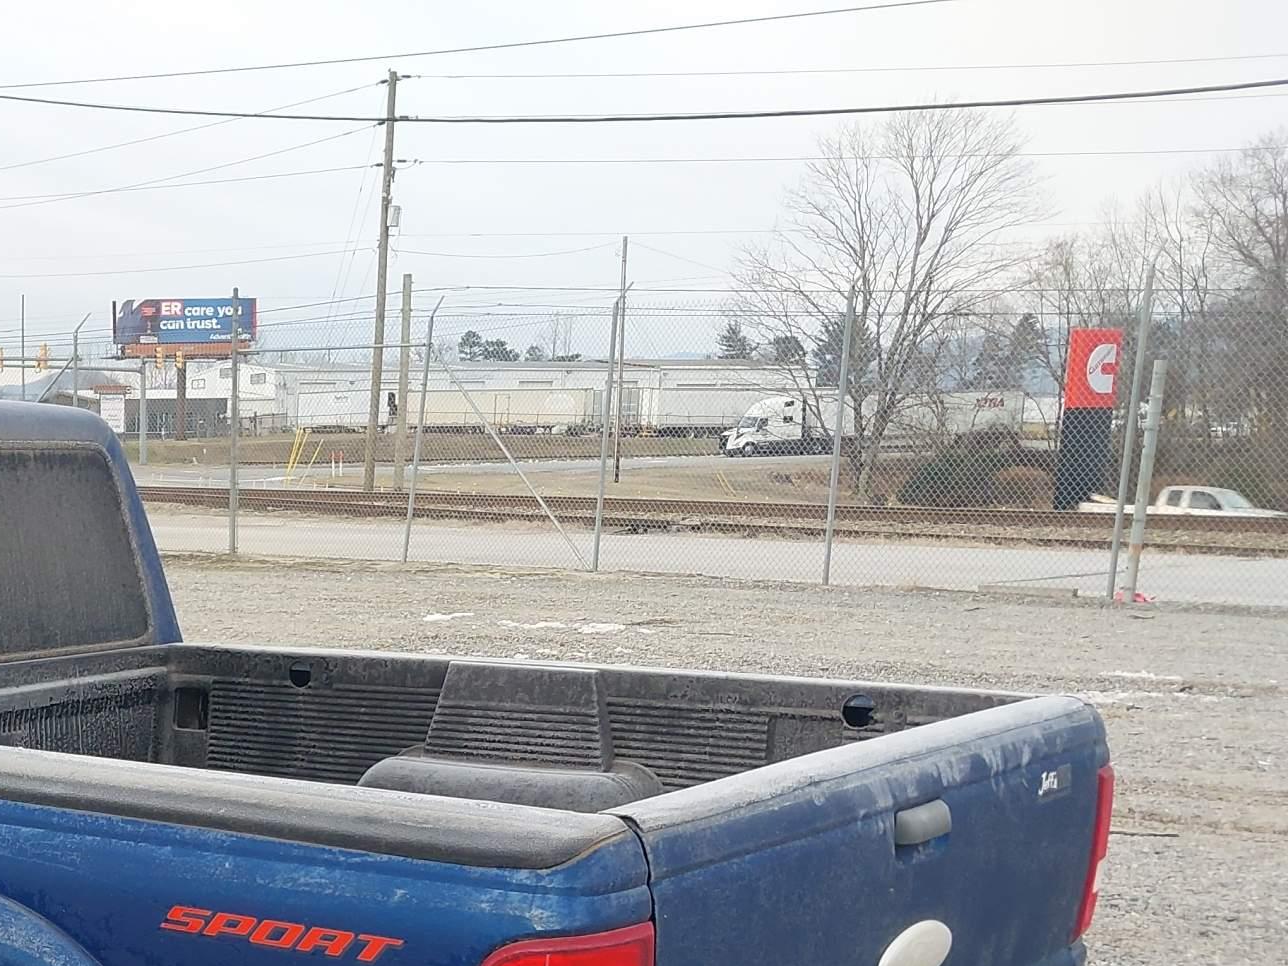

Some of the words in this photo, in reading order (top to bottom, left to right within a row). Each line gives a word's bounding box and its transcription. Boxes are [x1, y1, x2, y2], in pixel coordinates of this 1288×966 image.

[161, 301, 182, 315] ER
[184, 305, 215, 316] care
[160, 319, 185, 330] can
[186, 318, 221, 330] trust.
[159, 904, 405, 963] SPORT
